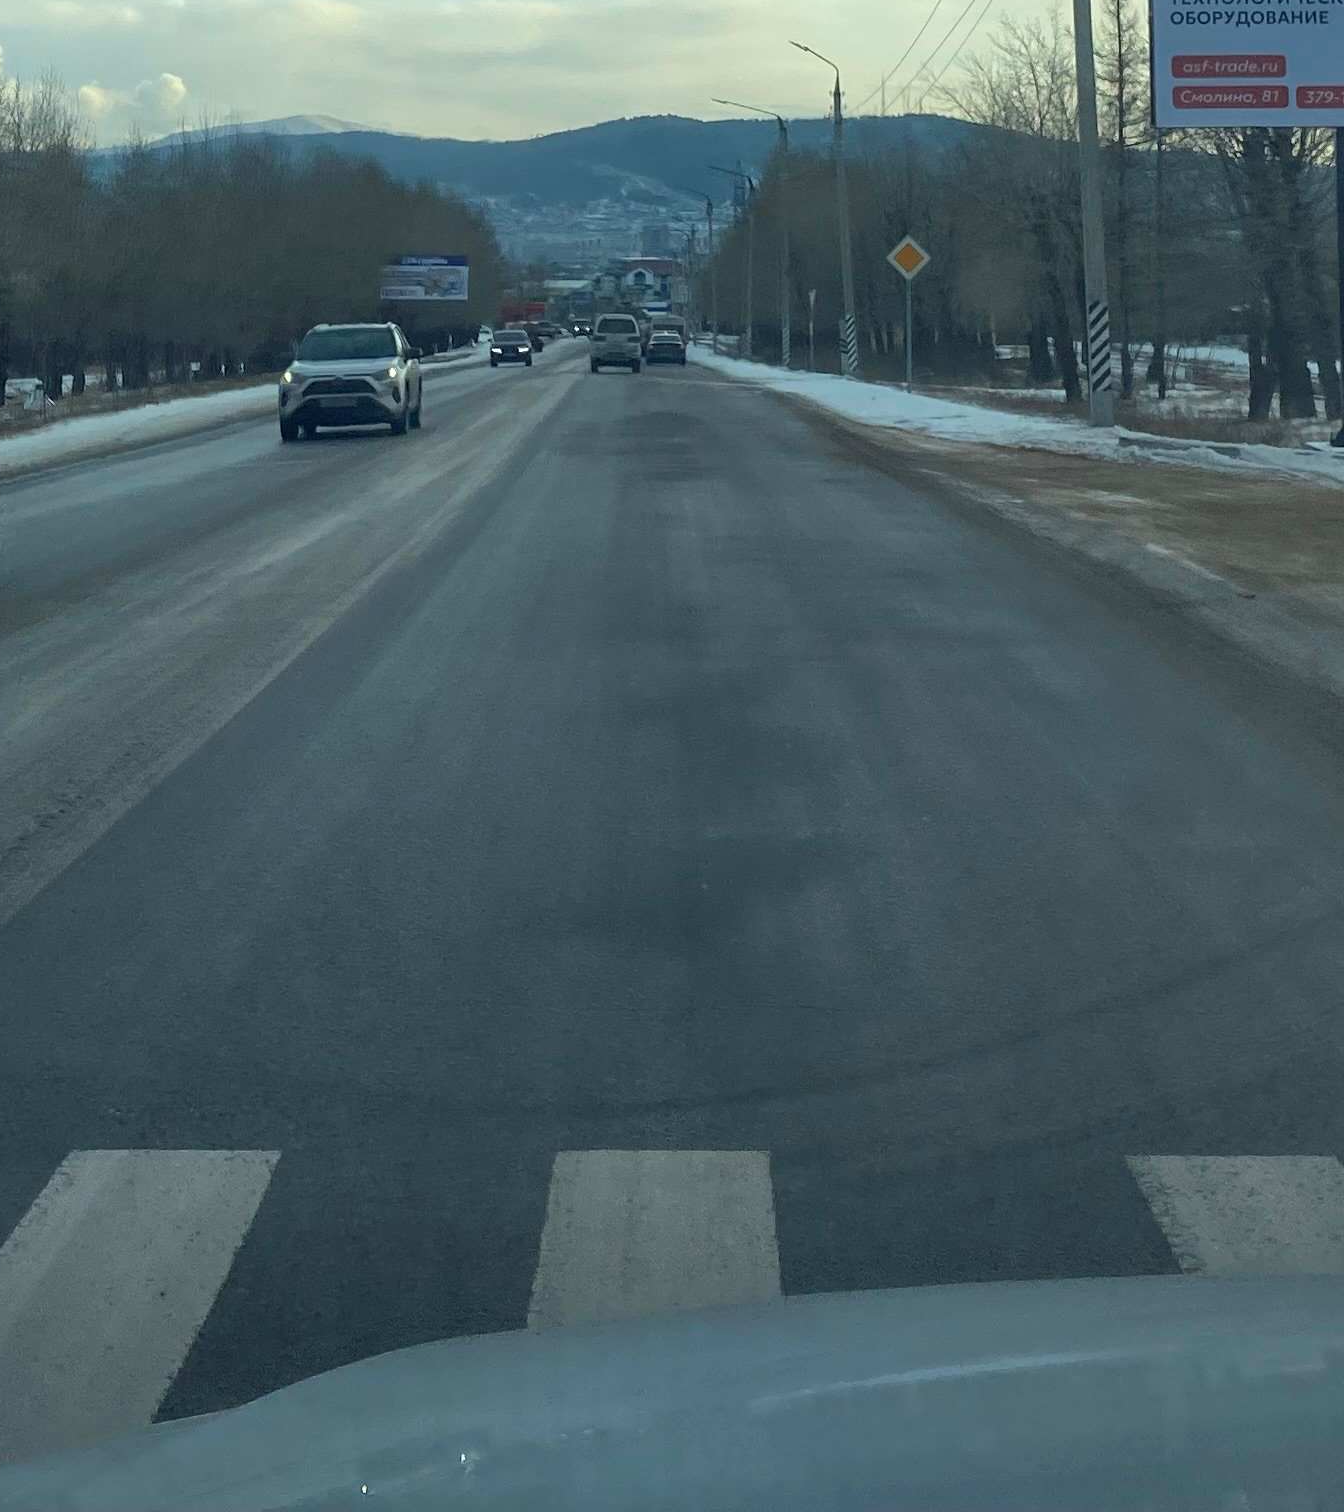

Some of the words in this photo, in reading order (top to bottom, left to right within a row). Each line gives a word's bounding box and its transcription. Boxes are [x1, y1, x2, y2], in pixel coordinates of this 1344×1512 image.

[1170, 10, 1329, 28] ОБОРУДОВАНИЕ
[1183, 59, 1279, 73] asf-trade.ru
[1180, 90, 1257, 104] Смолина,
[1261, 90, 1279, 103] 81
